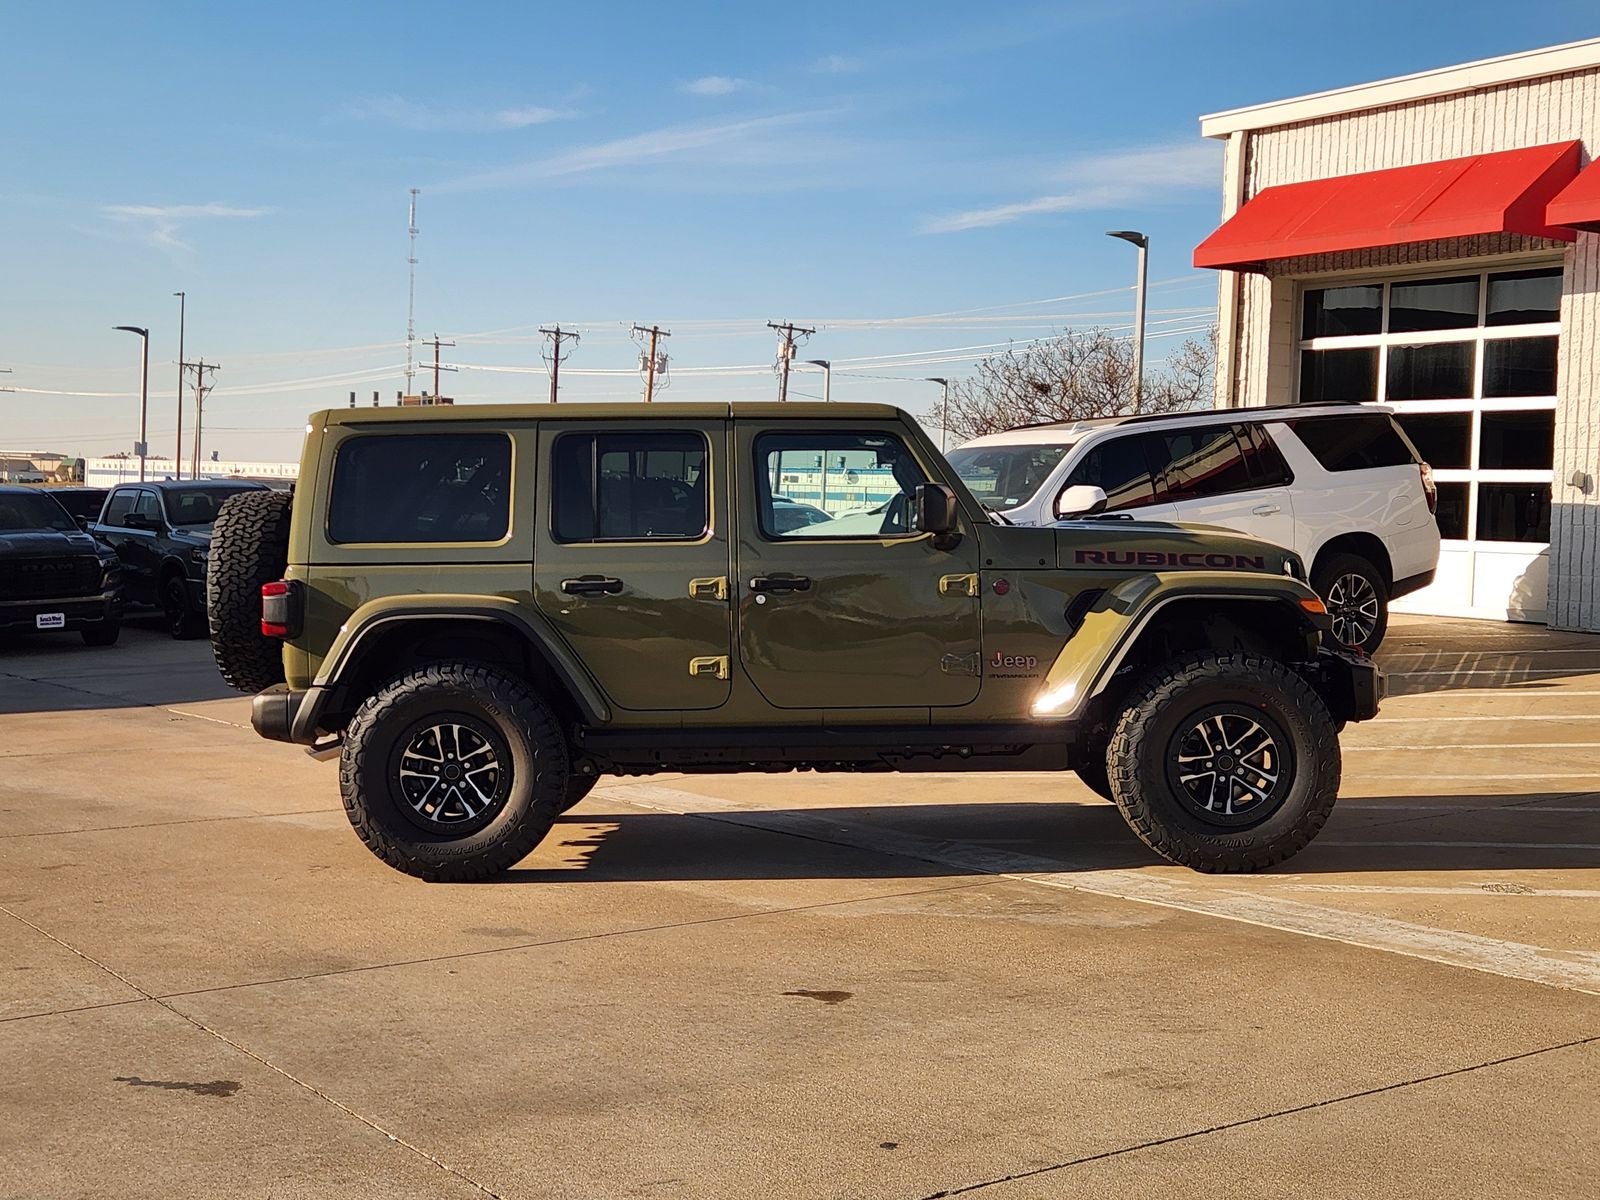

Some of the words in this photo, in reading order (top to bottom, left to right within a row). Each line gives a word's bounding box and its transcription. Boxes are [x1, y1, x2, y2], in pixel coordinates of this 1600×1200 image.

[21, 562, 75, 572] RAM
[1075, 550, 1266, 569] RUBICON
[991, 651, 1037, 670] Jeep
